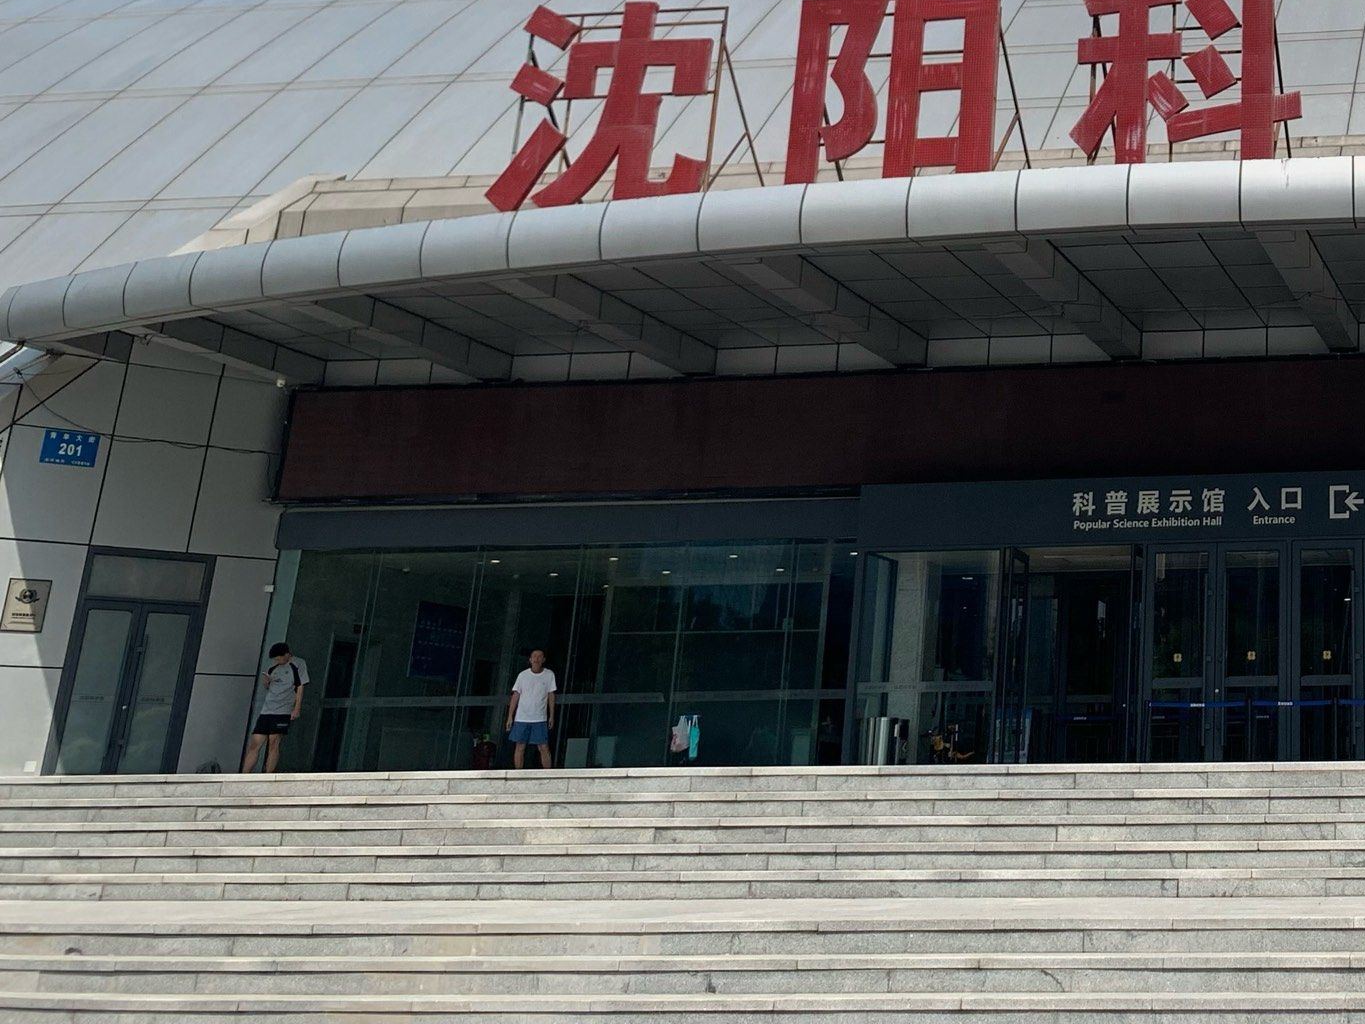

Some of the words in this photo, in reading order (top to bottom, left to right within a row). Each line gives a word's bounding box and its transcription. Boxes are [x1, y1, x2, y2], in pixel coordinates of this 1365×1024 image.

[58, 442, 82, 456] 201
[1072, 488, 1225, 516] 科普展示馆
[1247, 486, 1302, 511] 入口
[1073, 519, 1110, 531] Popular
[1113, 518, 1150, 528] Science
[1152, 517, 1200, 527] Exhibition
[1202, 516, 1222, 526] Hall
[1253, 515, 1296, 525] Entrance
